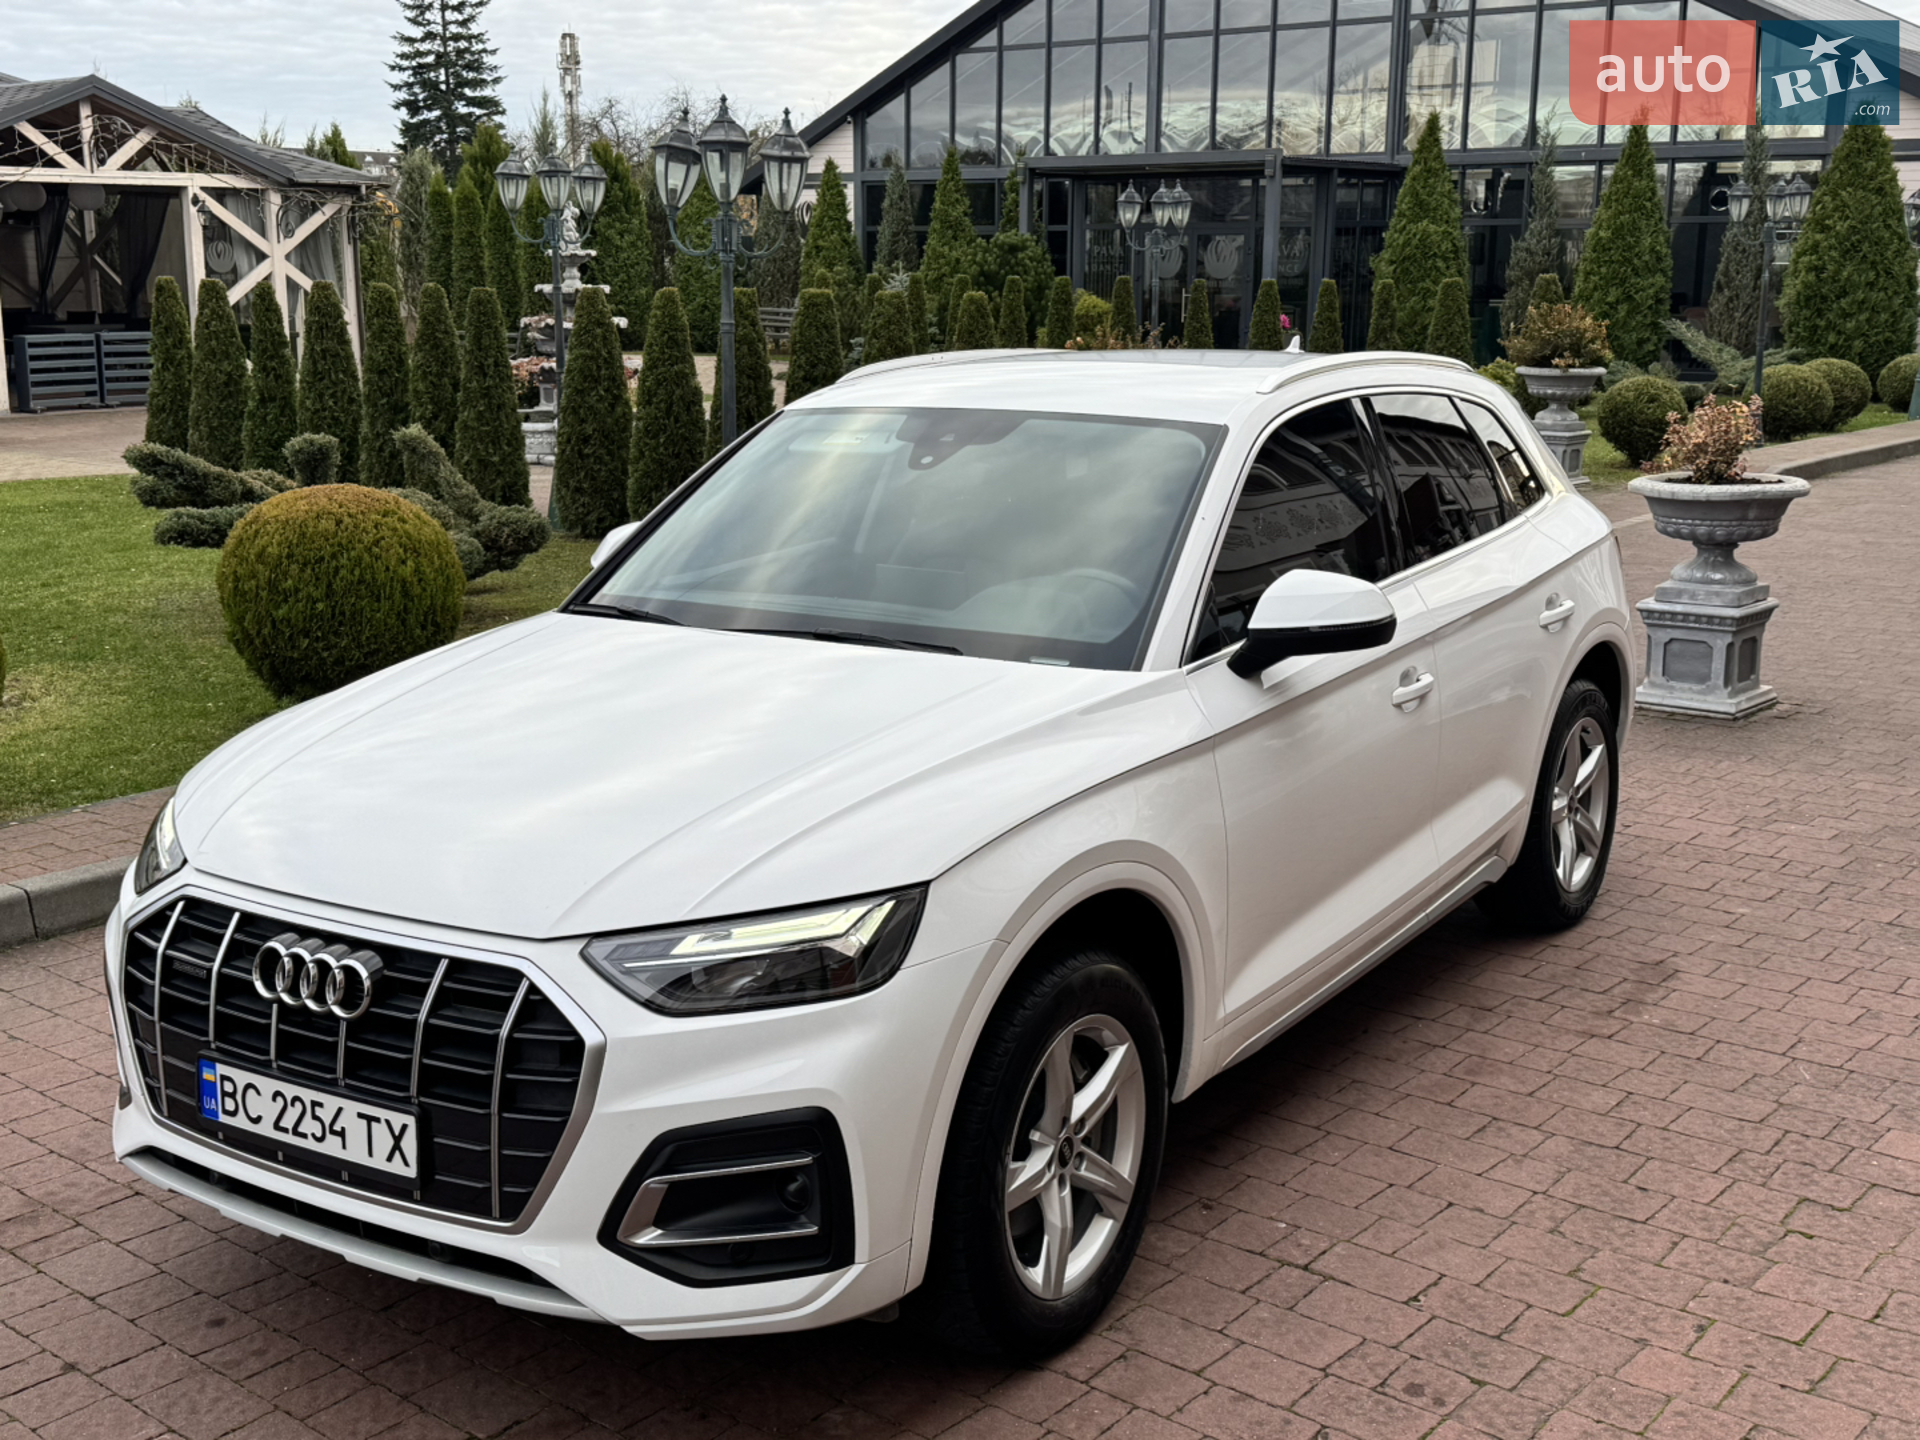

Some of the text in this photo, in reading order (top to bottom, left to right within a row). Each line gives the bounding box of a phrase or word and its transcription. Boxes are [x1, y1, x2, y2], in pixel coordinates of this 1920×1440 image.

[1093, 244, 1125, 257] PAVA
[203, 1096, 217, 1111] UA
[219, 1073, 411, 1168] BC 2254 TX
